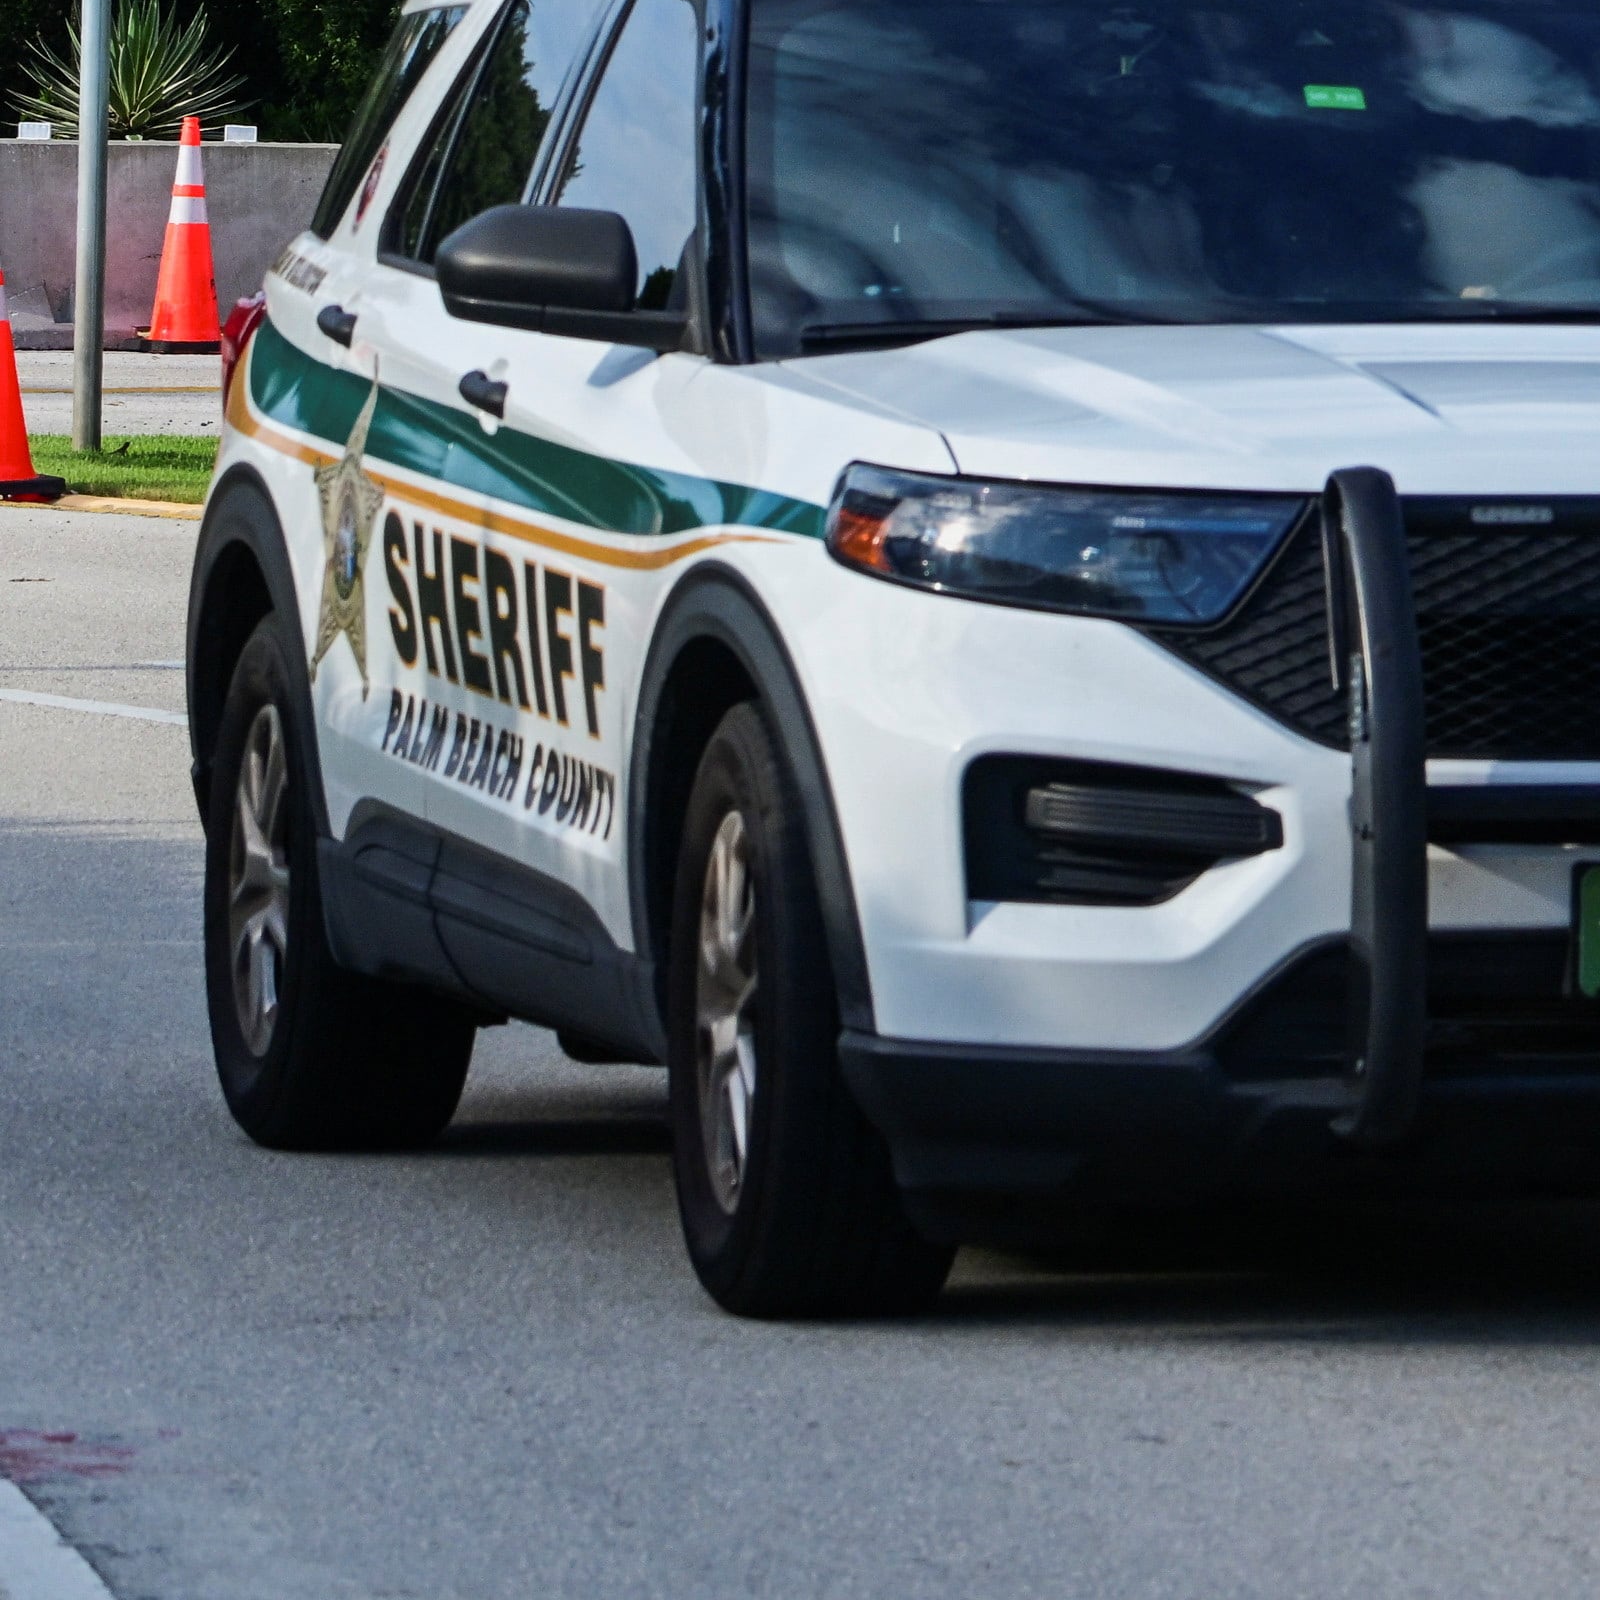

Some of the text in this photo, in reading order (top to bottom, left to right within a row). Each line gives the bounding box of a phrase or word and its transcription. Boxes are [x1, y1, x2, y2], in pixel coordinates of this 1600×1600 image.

[383, 506, 607, 741] SHERIFF
[382, 688, 615, 842] PALM BEACH COUNTY
